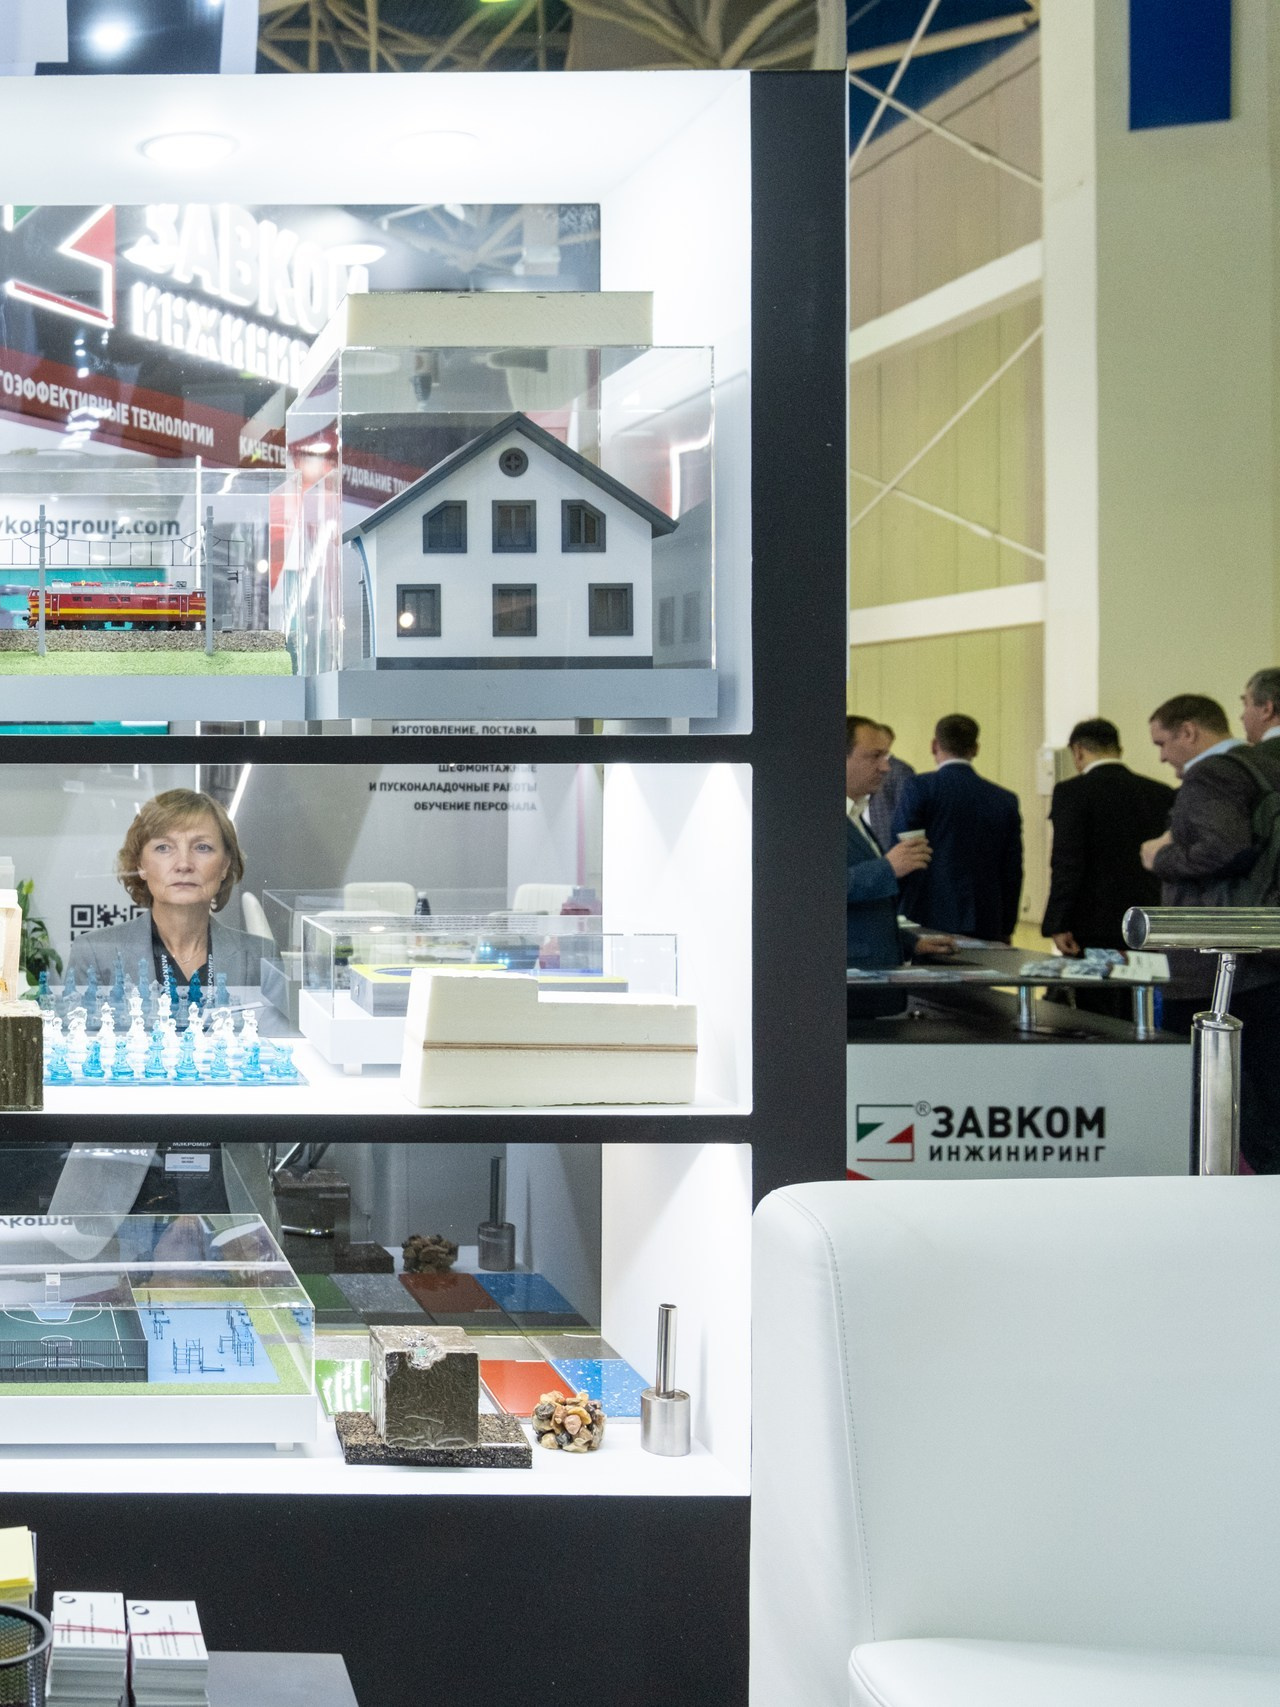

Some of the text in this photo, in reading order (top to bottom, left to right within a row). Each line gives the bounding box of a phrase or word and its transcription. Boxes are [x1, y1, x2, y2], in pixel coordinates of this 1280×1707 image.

[132, 406, 215, 448] ТЕХНОЛОГИИ
[392, 725, 538, 736] ИЗГОТОВЛЕНИЕ, ПОСТАВКА
[369, 782, 538, 794] И ПУСКОНАЛАДОЧНЫЕ РАБОТЫ
[414, 801, 537, 812] ОБУЧЕНИЕ ПЕРСОНАЛА
[930, 1106, 1106, 1139] ЗАВКОМ
[929, 1145, 1106, 1162] ИНЖИНИРИНГ
